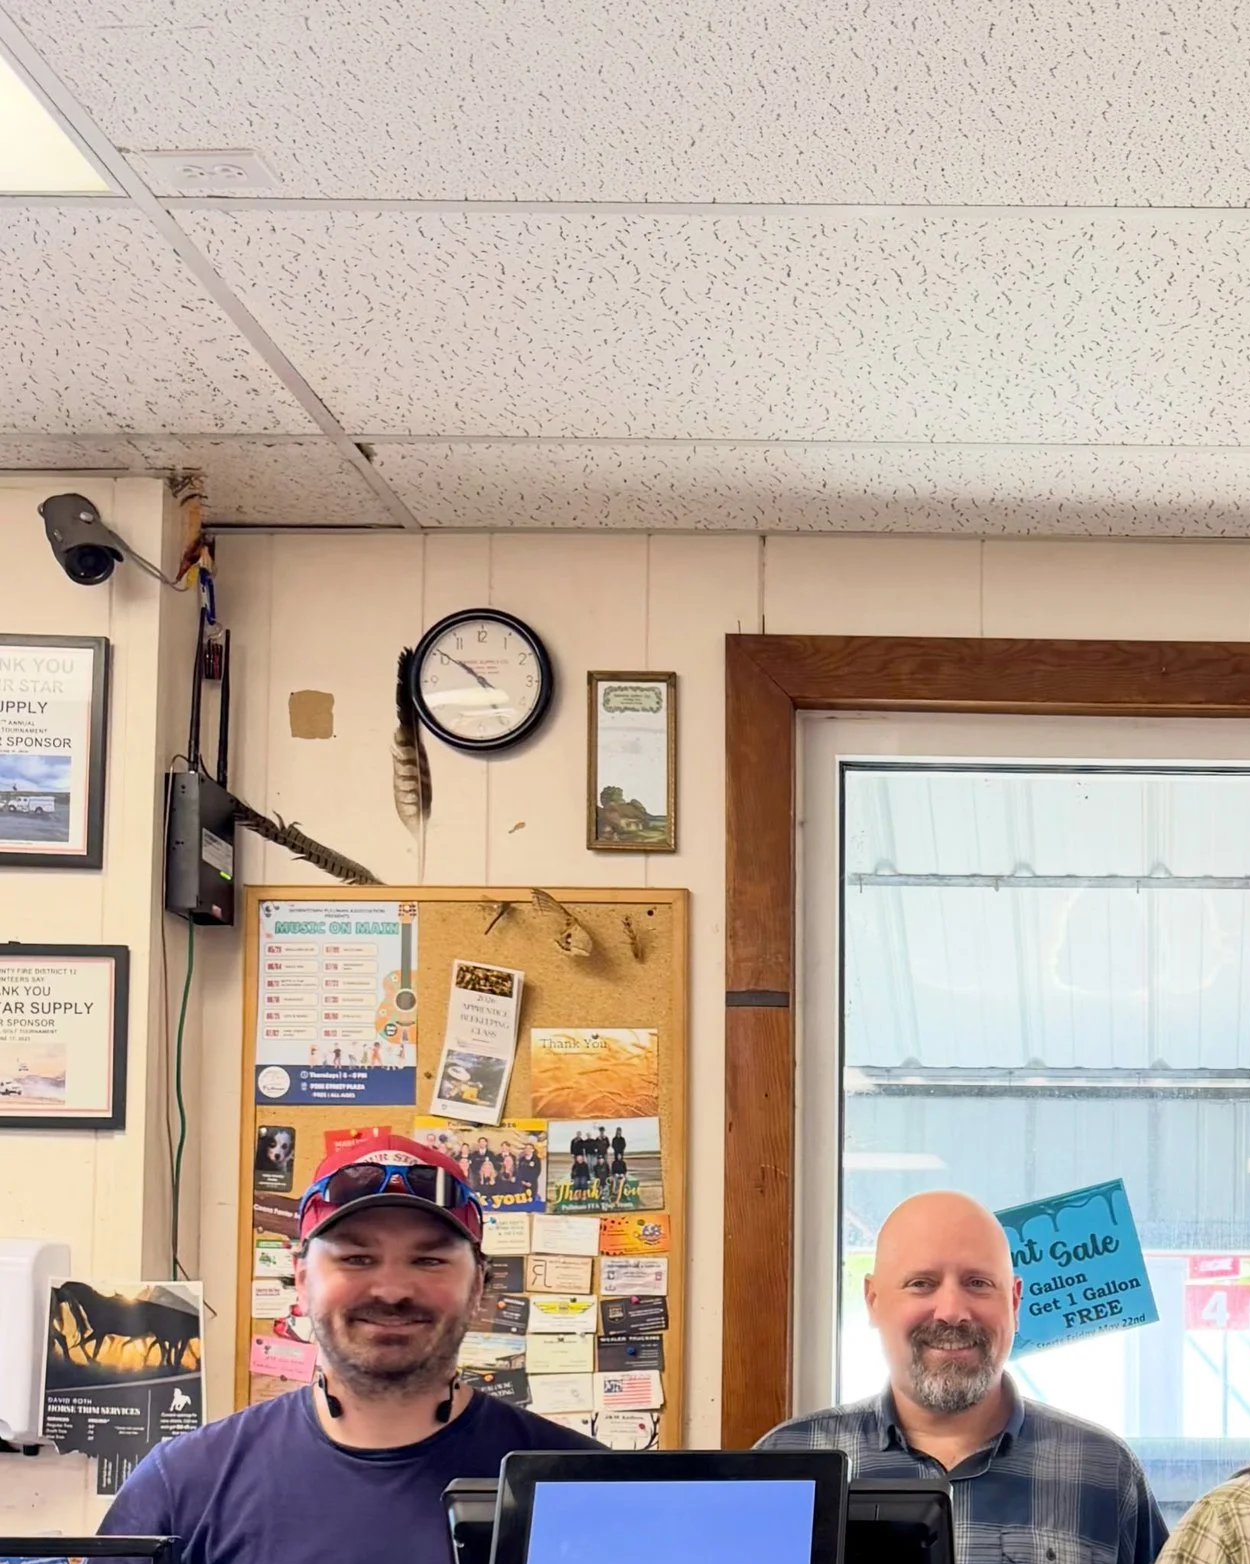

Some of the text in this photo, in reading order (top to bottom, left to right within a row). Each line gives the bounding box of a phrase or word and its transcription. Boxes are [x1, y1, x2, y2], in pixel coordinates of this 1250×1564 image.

[456, 637, 463, 650] 11
[477, 630, 488, 643] 12
[32, 657, 75, 674] YOU
[518, 652, 528, 666] 2
[19, 678, 65, 694] STAR
[526, 675, 534, 688] 3
[6, 736, 72, 749] SPONSOR
[274, 921, 400, 935] MUSIC ON MAIN
[69, 968, 78, 976] 12
[23, 985, 52, 997] YOU
[30, 1001, 94, 1015] SUPPLY
[6, 1018, 56, 1027] SPONSOR
[540, 1037, 607, 1050] Thank You
[556, 1176, 642, 1204] Thank You
[490, 1187, 533, 1208] you!
[1049, 1232, 1120, 1268] Sale
[1029, 1271, 1088, 1297] Gallon
[1028, 1276, 1142, 1316] Get 1 Gallon
[1062, 1299, 1124, 1329] FREE
[1201, 1290, 1230, 1326] 4
[1122, 1313, 1146, 1327] 22nd
[47, 1404, 141, 1416] HORSE TRIM SERVICES
